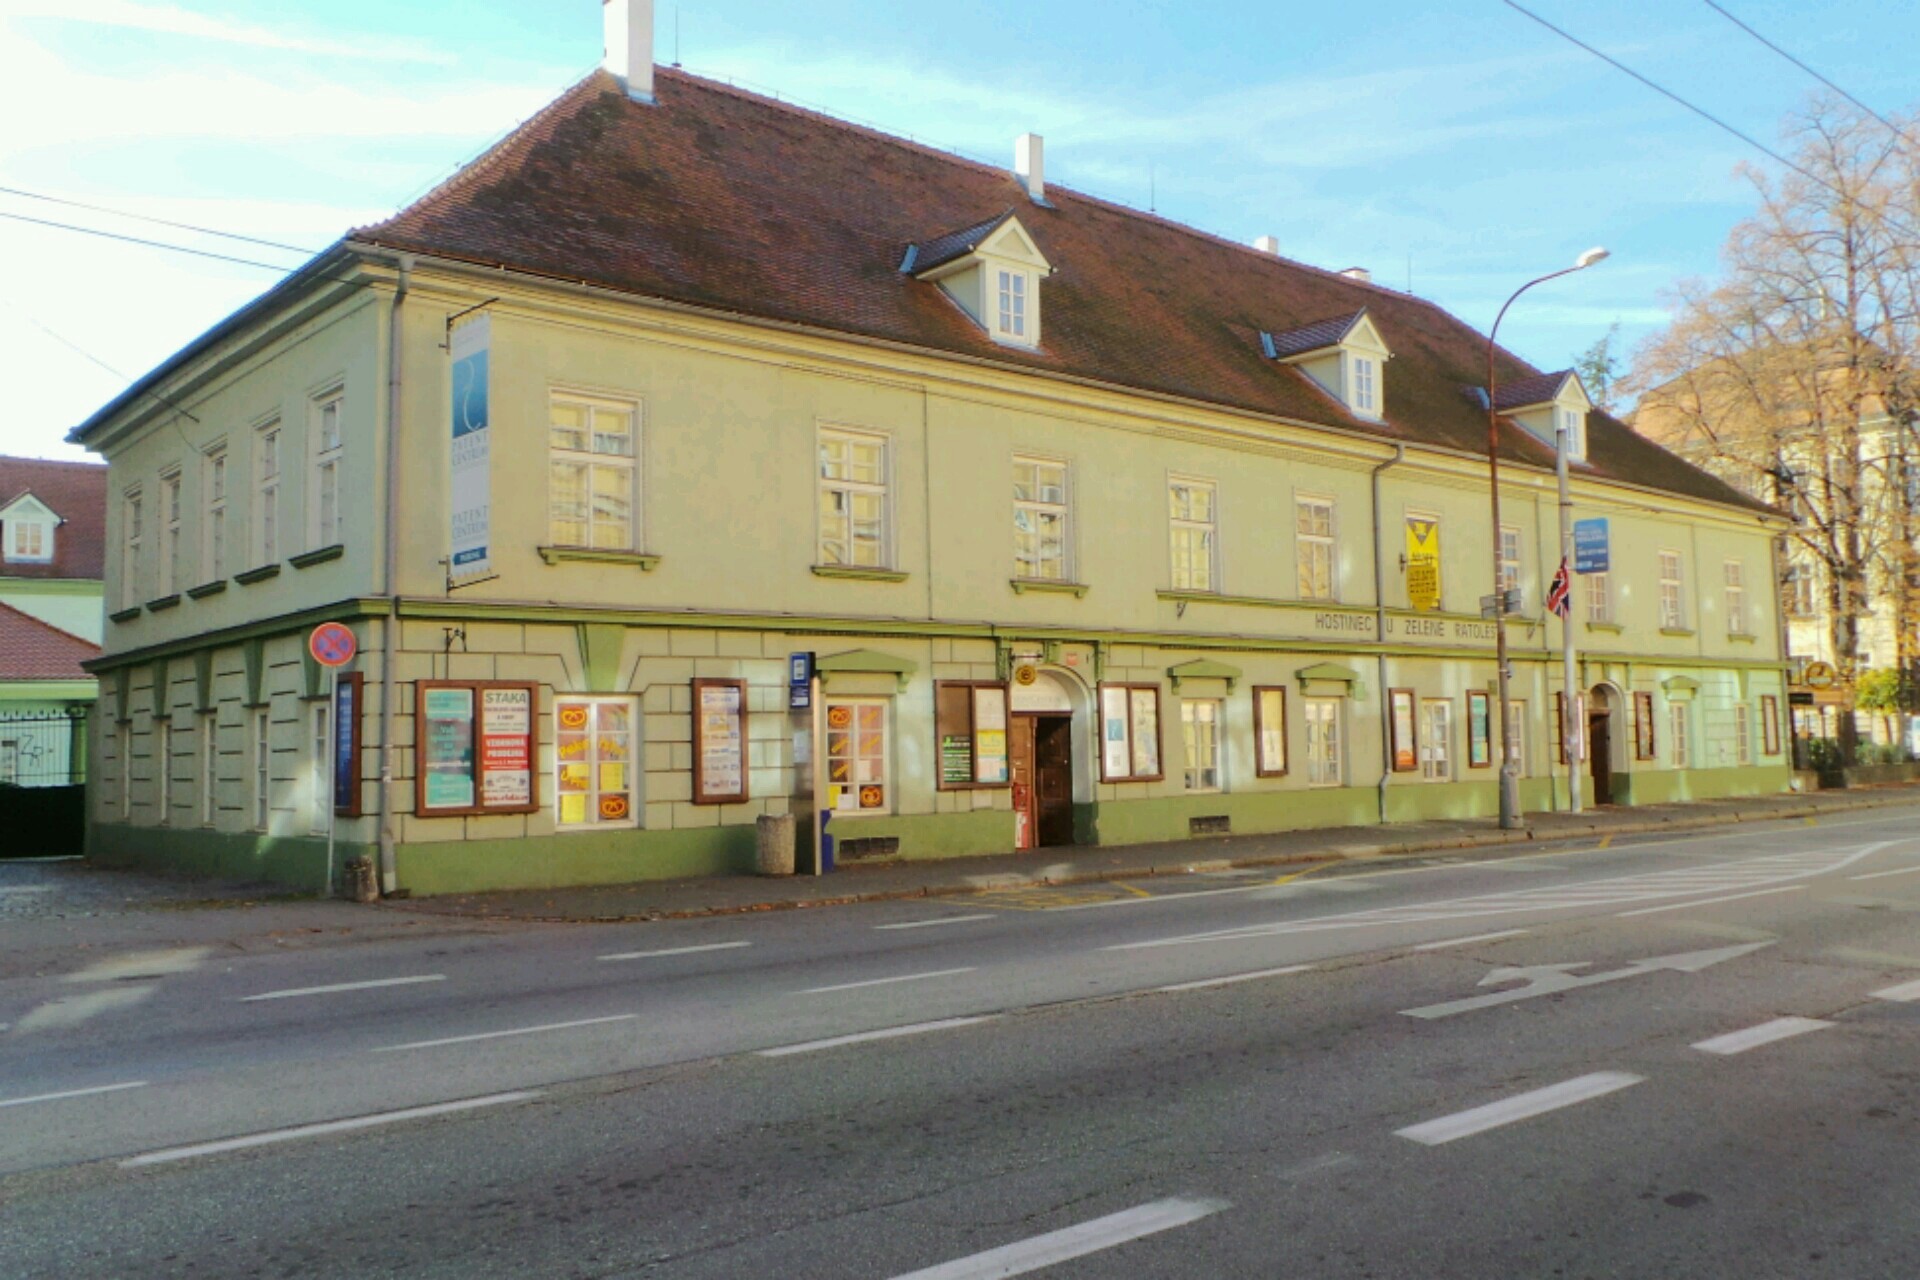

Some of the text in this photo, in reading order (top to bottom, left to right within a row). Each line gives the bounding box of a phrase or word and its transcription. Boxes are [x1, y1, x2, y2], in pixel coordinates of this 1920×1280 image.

[1315, 613, 1372, 632] HOSTINEC
[1386, 618, 1393, 633] U
[1455, 623, 1499, 640] RATOLES
[485, 692, 527, 704] STAKA
